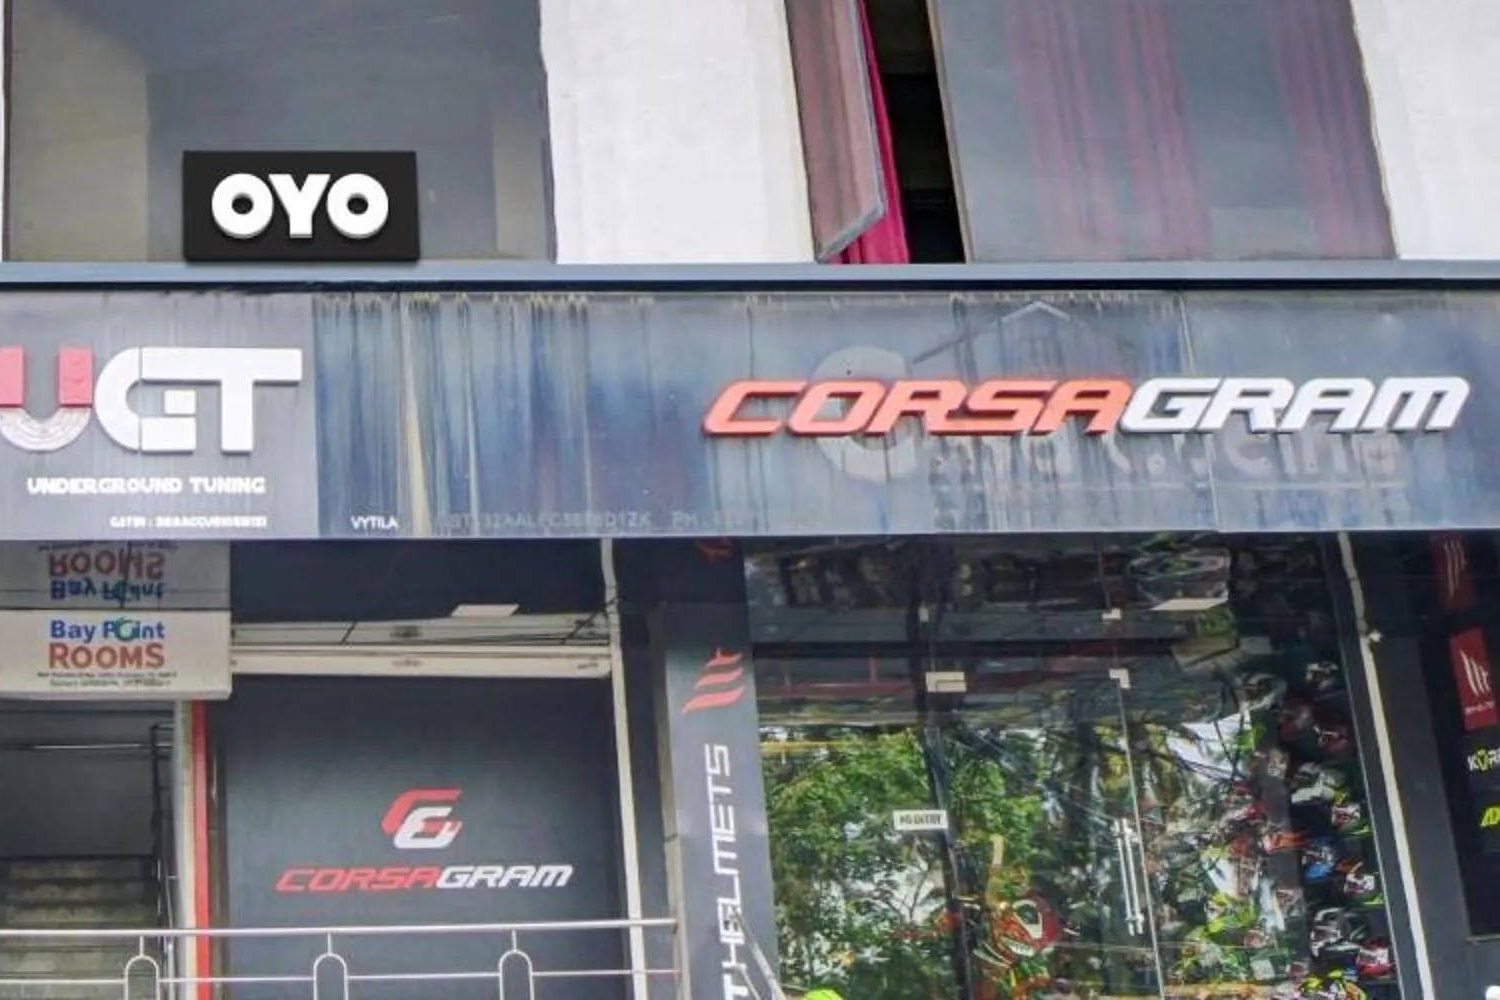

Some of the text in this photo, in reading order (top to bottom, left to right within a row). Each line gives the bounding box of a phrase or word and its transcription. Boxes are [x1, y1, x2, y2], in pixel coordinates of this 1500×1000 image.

[211, 173, 389, 239] OYO
[703, 377, 1470, 435] CORSAGRAM
[27, 476, 266, 495] UNDERGROUND TUNING
[51, 616, 165, 642] Bay Point
[51, 643, 164, 669] ROOMS
[275, 864, 573, 892] CORSAGRAM
